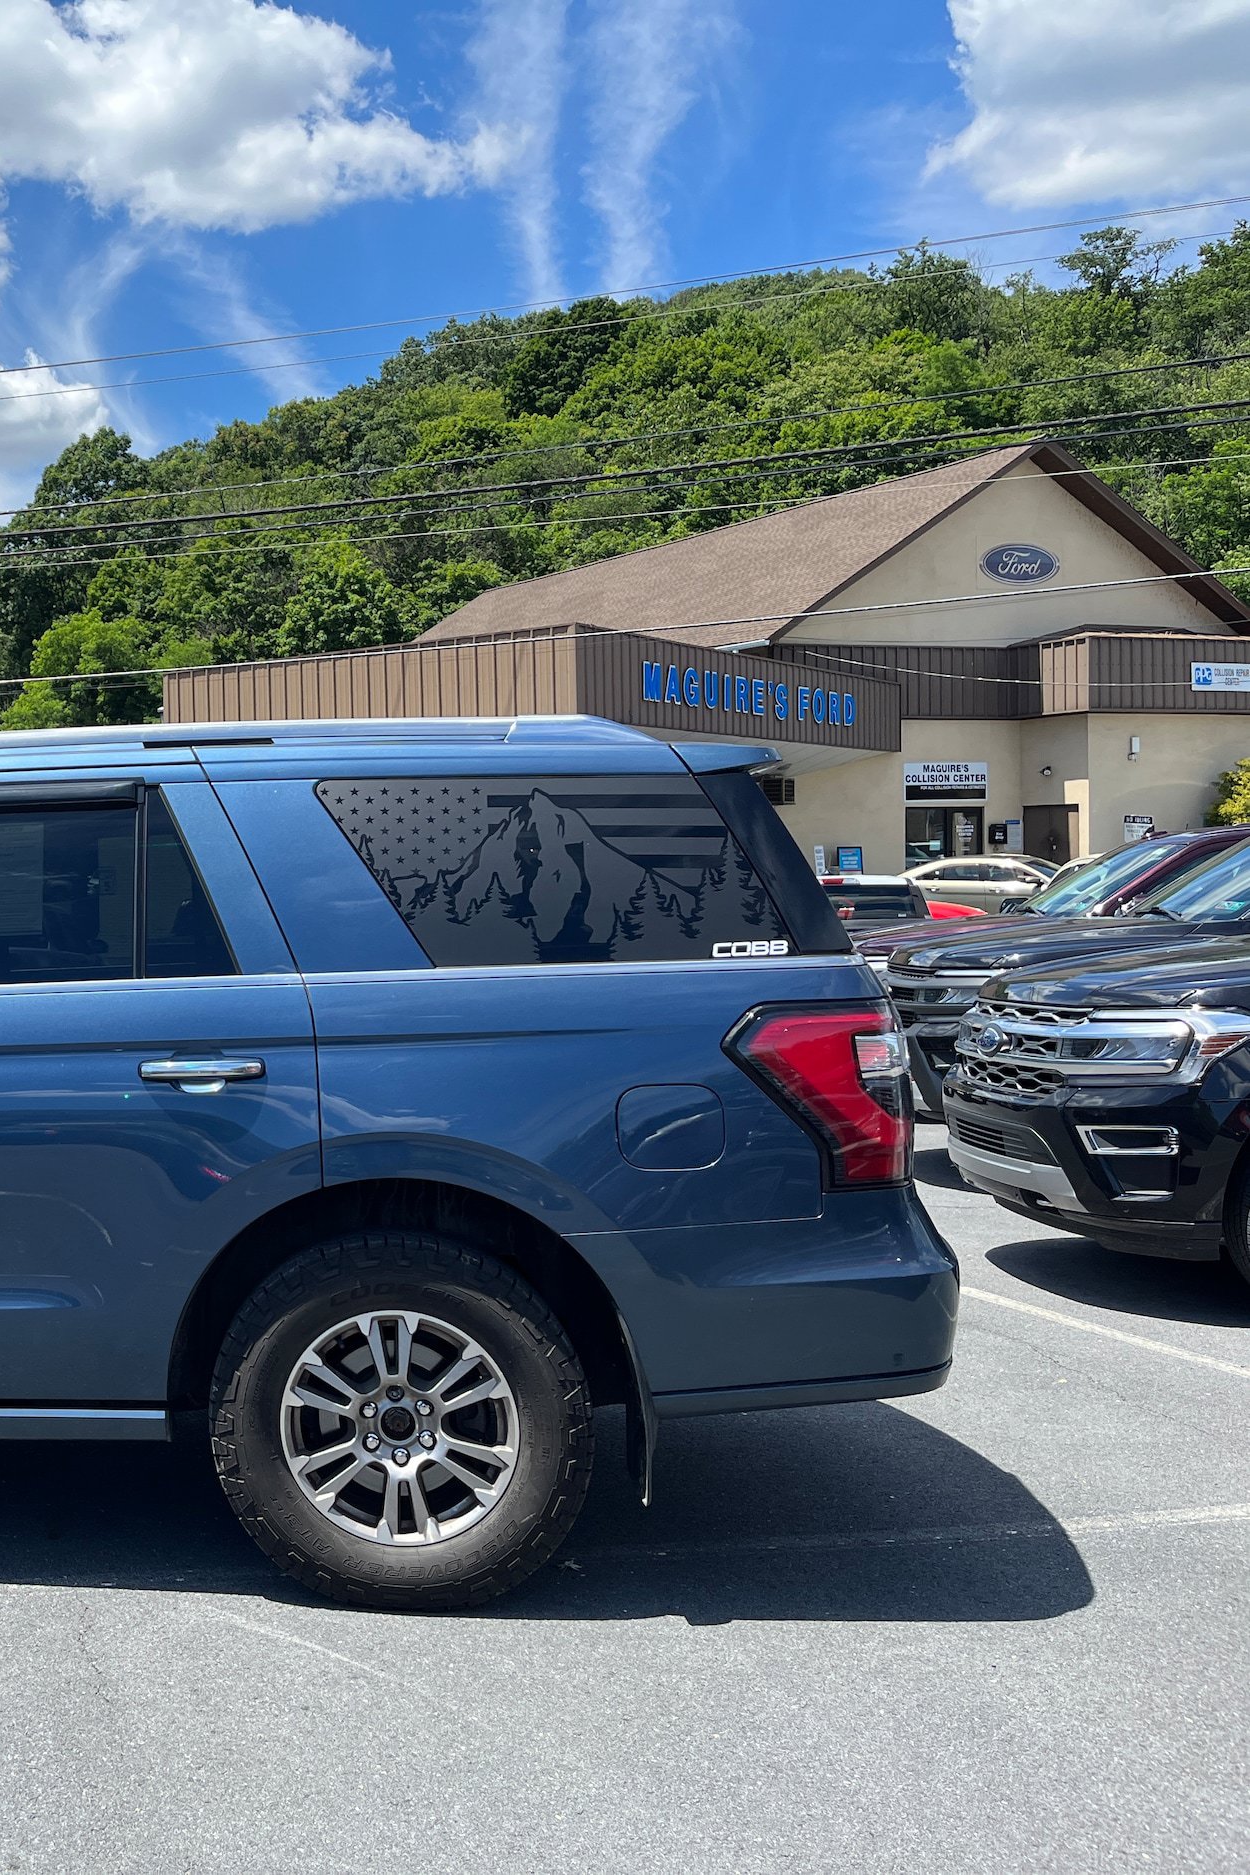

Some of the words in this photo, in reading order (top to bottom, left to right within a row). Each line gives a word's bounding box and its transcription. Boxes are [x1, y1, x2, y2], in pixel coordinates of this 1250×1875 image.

[998, 550, 1041, 576] Ford
[642, 660, 789, 721] MAGUIRE'S
[797, 685, 856, 727] FORD
[922, 764, 970, 773] MAGUIRE'S
[905, 774, 950, 783] COLLISION
[952, 774, 987, 783] CENTER
[712, 940, 789, 957] COBB
